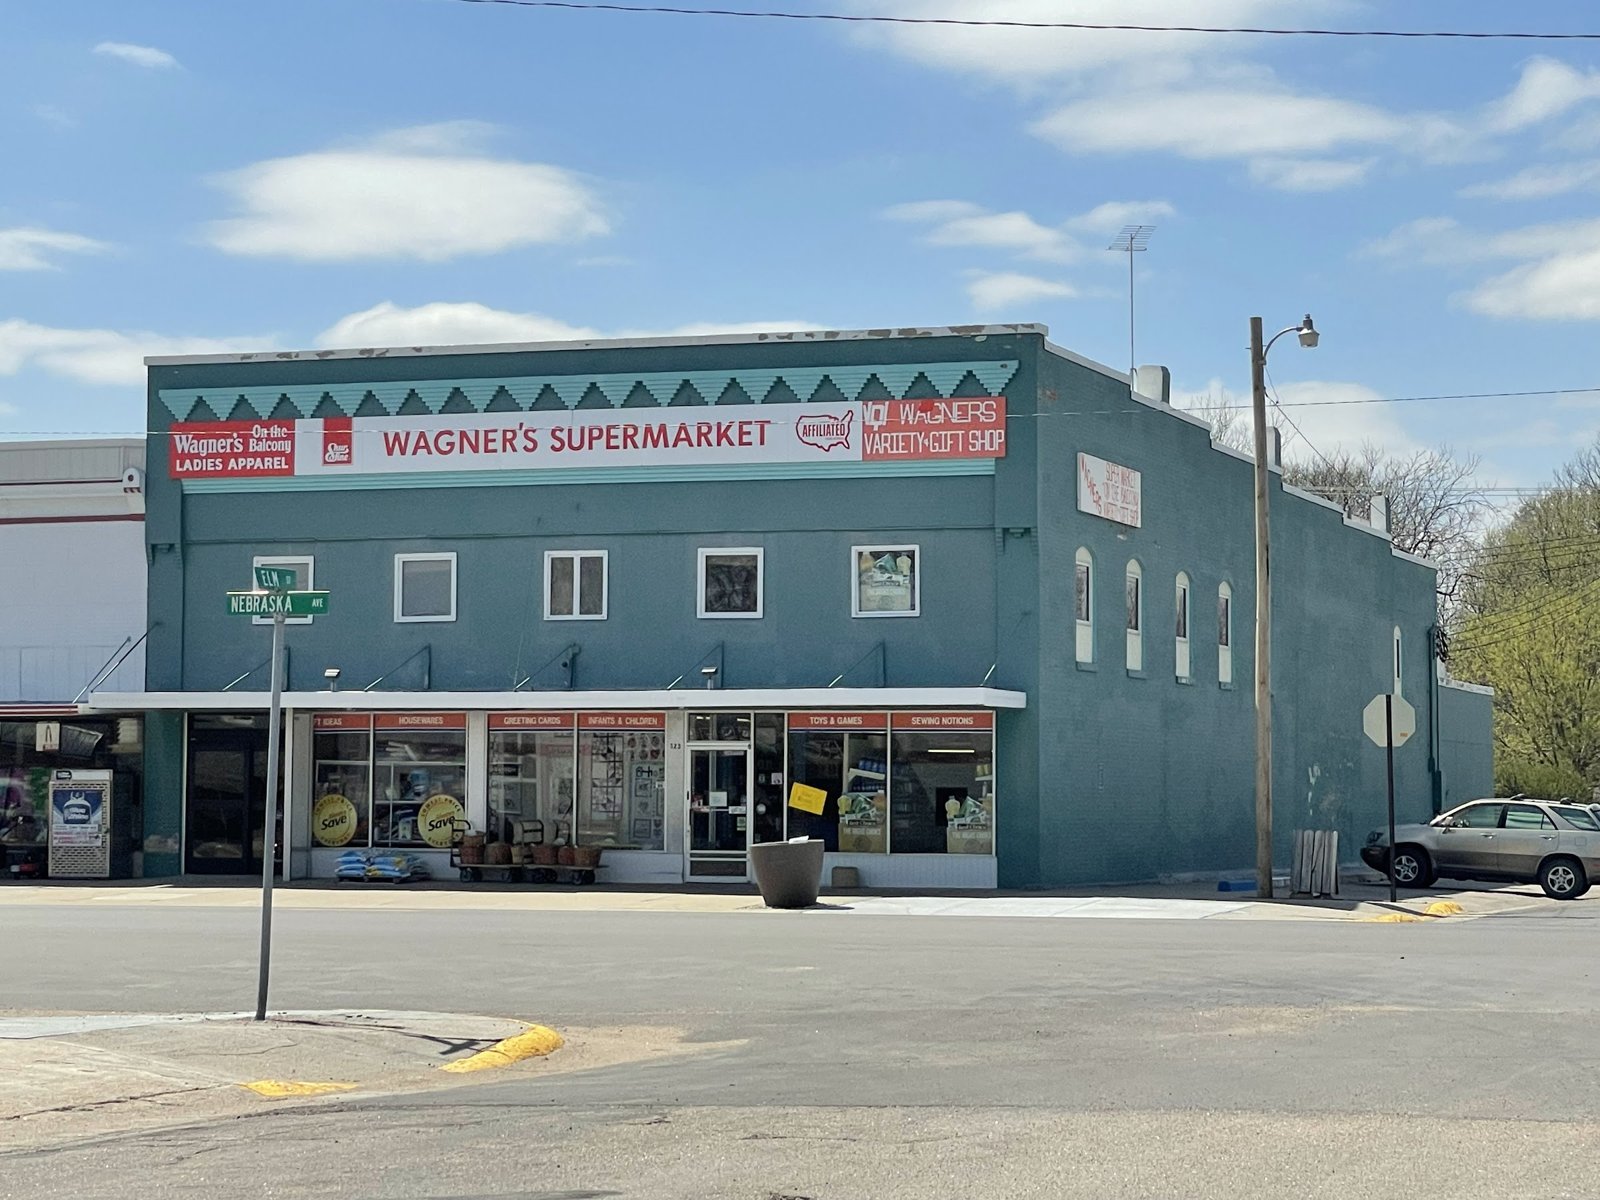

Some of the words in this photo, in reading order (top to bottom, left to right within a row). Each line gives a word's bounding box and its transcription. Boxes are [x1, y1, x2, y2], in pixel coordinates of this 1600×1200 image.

[900, 401, 996, 425] WAGNERS
[253, 424, 267, 438] On
[270, 425, 287, 438] the
[802, 423, 845, 437] AFFILIATED
[173, 432, 243, 457] Wagner's
[249, 438, 291, 453] Balcony
[383, 422, 538, 457] WAGNER'S
[550, 420, 771, 453] SUPERMARKET
[864, 431, 924, 454] VARIETY
[929, 430, 965, 453] GIFT
[969, 430, 1004, 452] SHOP
[176, 458, 223, 472] LADIES
[228, 456, 289, 470] APPAREL
[260, 570, 280, 587] ELM
[231, 595, 293, 613] NEBRASKA
[311, 598, 323, 608] AVE
[323, 718, 342, 726] IDEAS
[399, 716, 444, 725] HOUSEWARES
[504, 716, 537, 725] GREETING
[537, 716, 561, 725] CARDS
[588, 716, 615, 725] INFANTS
[617, 716, 623, 725] &
[625, 716, 658, 725] CHILDREN
[809, 716, 829, 725] TOYS
[829, 716, 835, 725] &
[836, 716, 863, 725] GAMES
[911, 716, 940, 725] SEWING
[941, 716, 974, 725] NOTIONS
[321, 815, 347, 830] Save
[428, 815, 455, 832] Save
